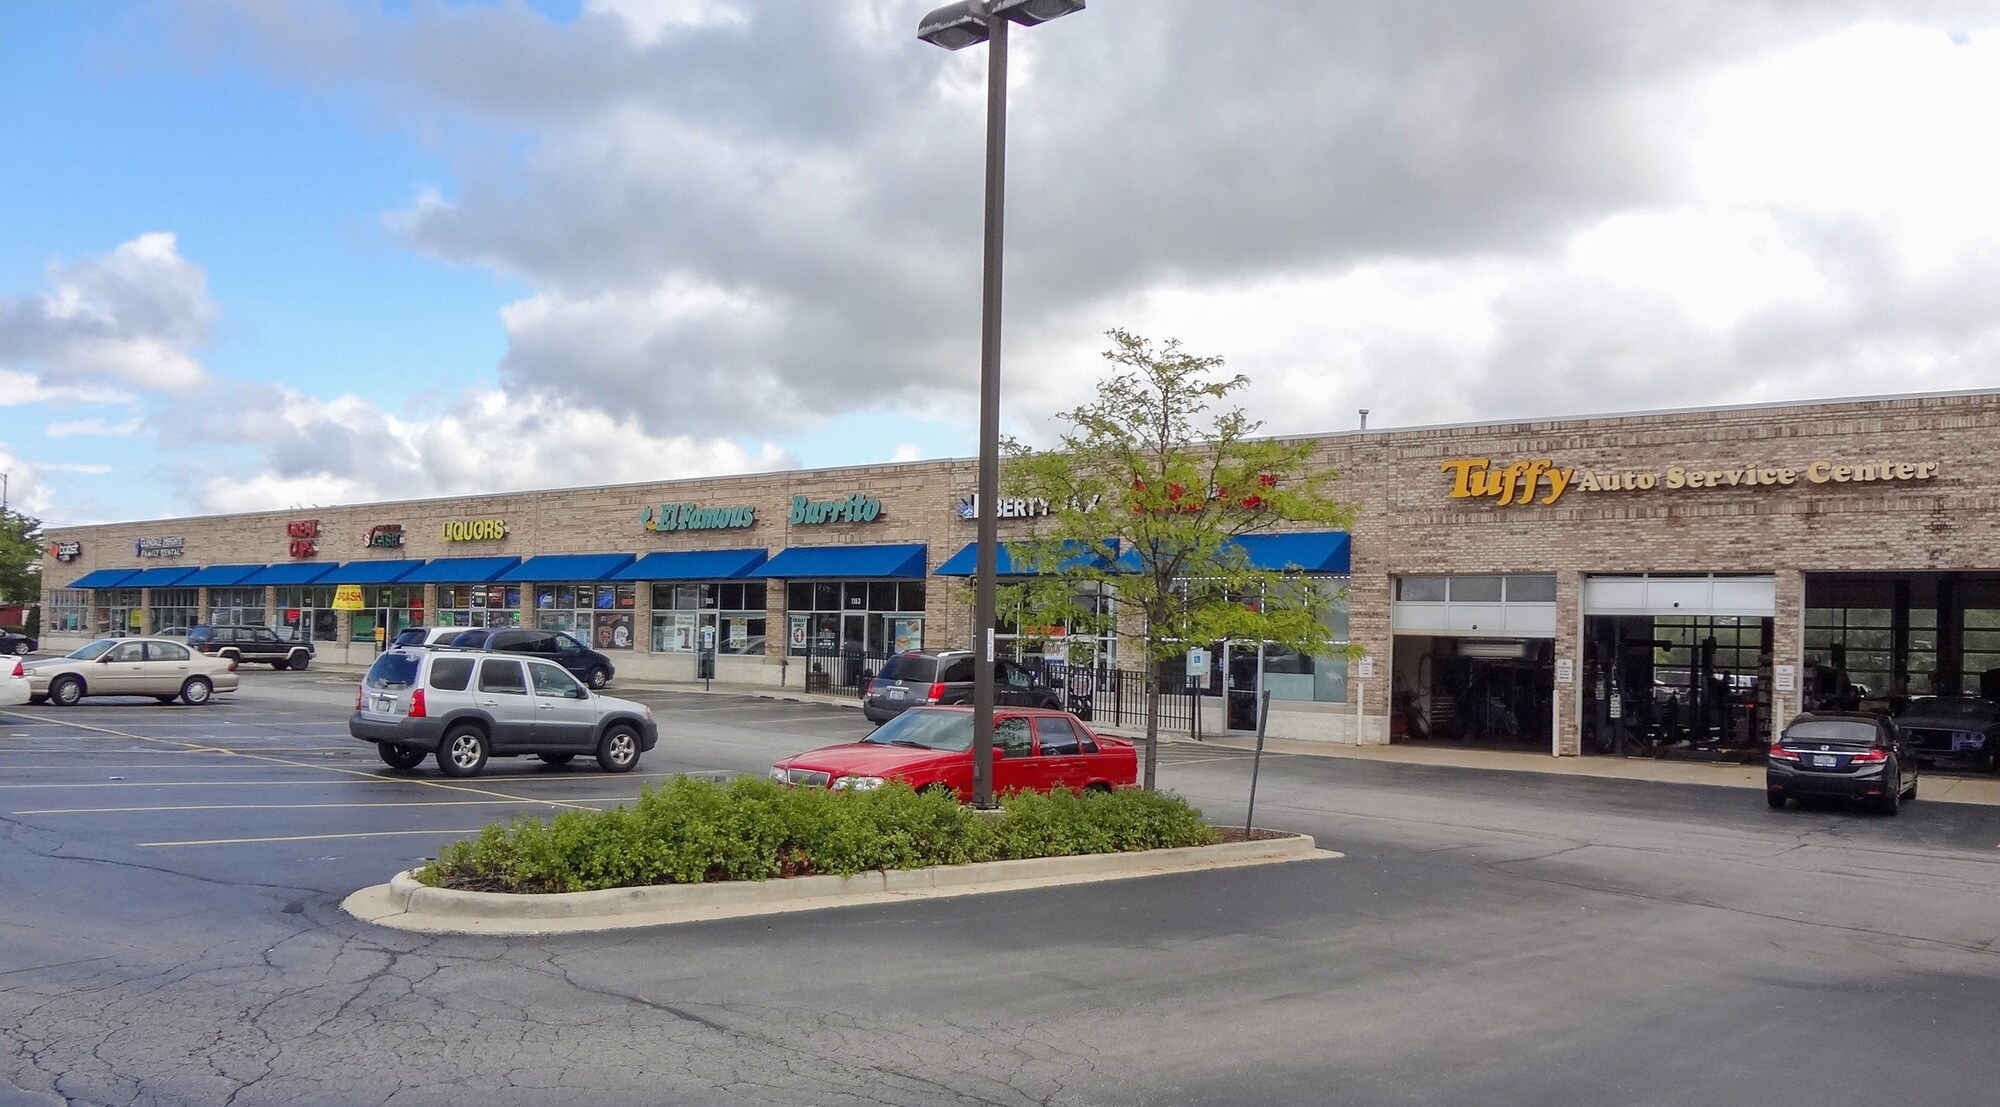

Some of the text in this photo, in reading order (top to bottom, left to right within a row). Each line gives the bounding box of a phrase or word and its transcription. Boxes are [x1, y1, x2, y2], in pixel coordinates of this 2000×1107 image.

[1440, 458, 1936, 505] Tuffy Auto Service Center
[656, 493, 881, 531] El Famous Burrito
[287, 520, 319, 538] GREAT
[442, 519, 504, 541] LIQUORS
